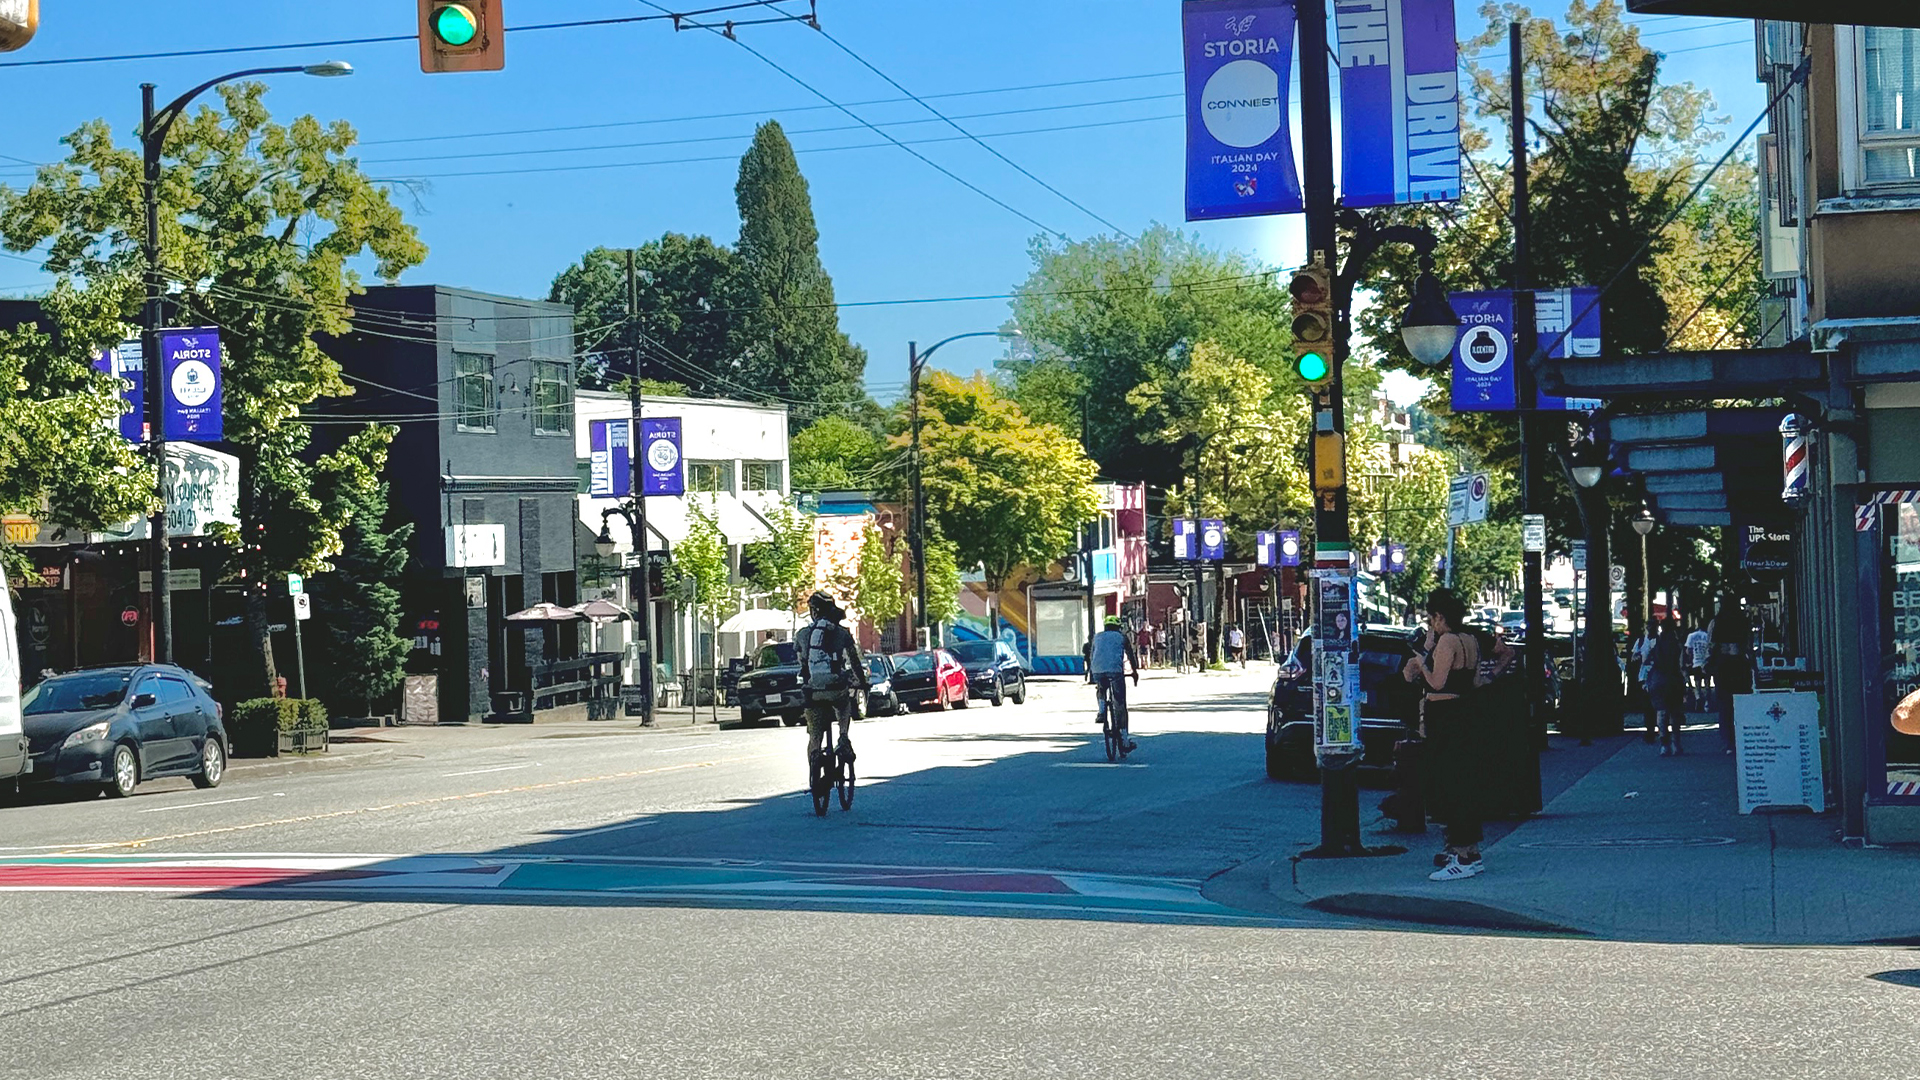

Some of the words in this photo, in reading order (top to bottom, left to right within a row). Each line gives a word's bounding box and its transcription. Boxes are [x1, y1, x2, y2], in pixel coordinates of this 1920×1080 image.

[1204, 38, 1280, 58] STORIA
[1406, 71, 1460, 202] DRIVE
[1211, 155, 1253, 164] ITALIAN
[1257, 153, 1278, 162] DAY
[1231, 164, 1258, 173] 2024
[1460, 314, 1504, 324] STORIA
[4, 524, 41, 544] SHOP
[1748, 525, 1765, 534] The
[1767, 532, 1791, 542] Store
